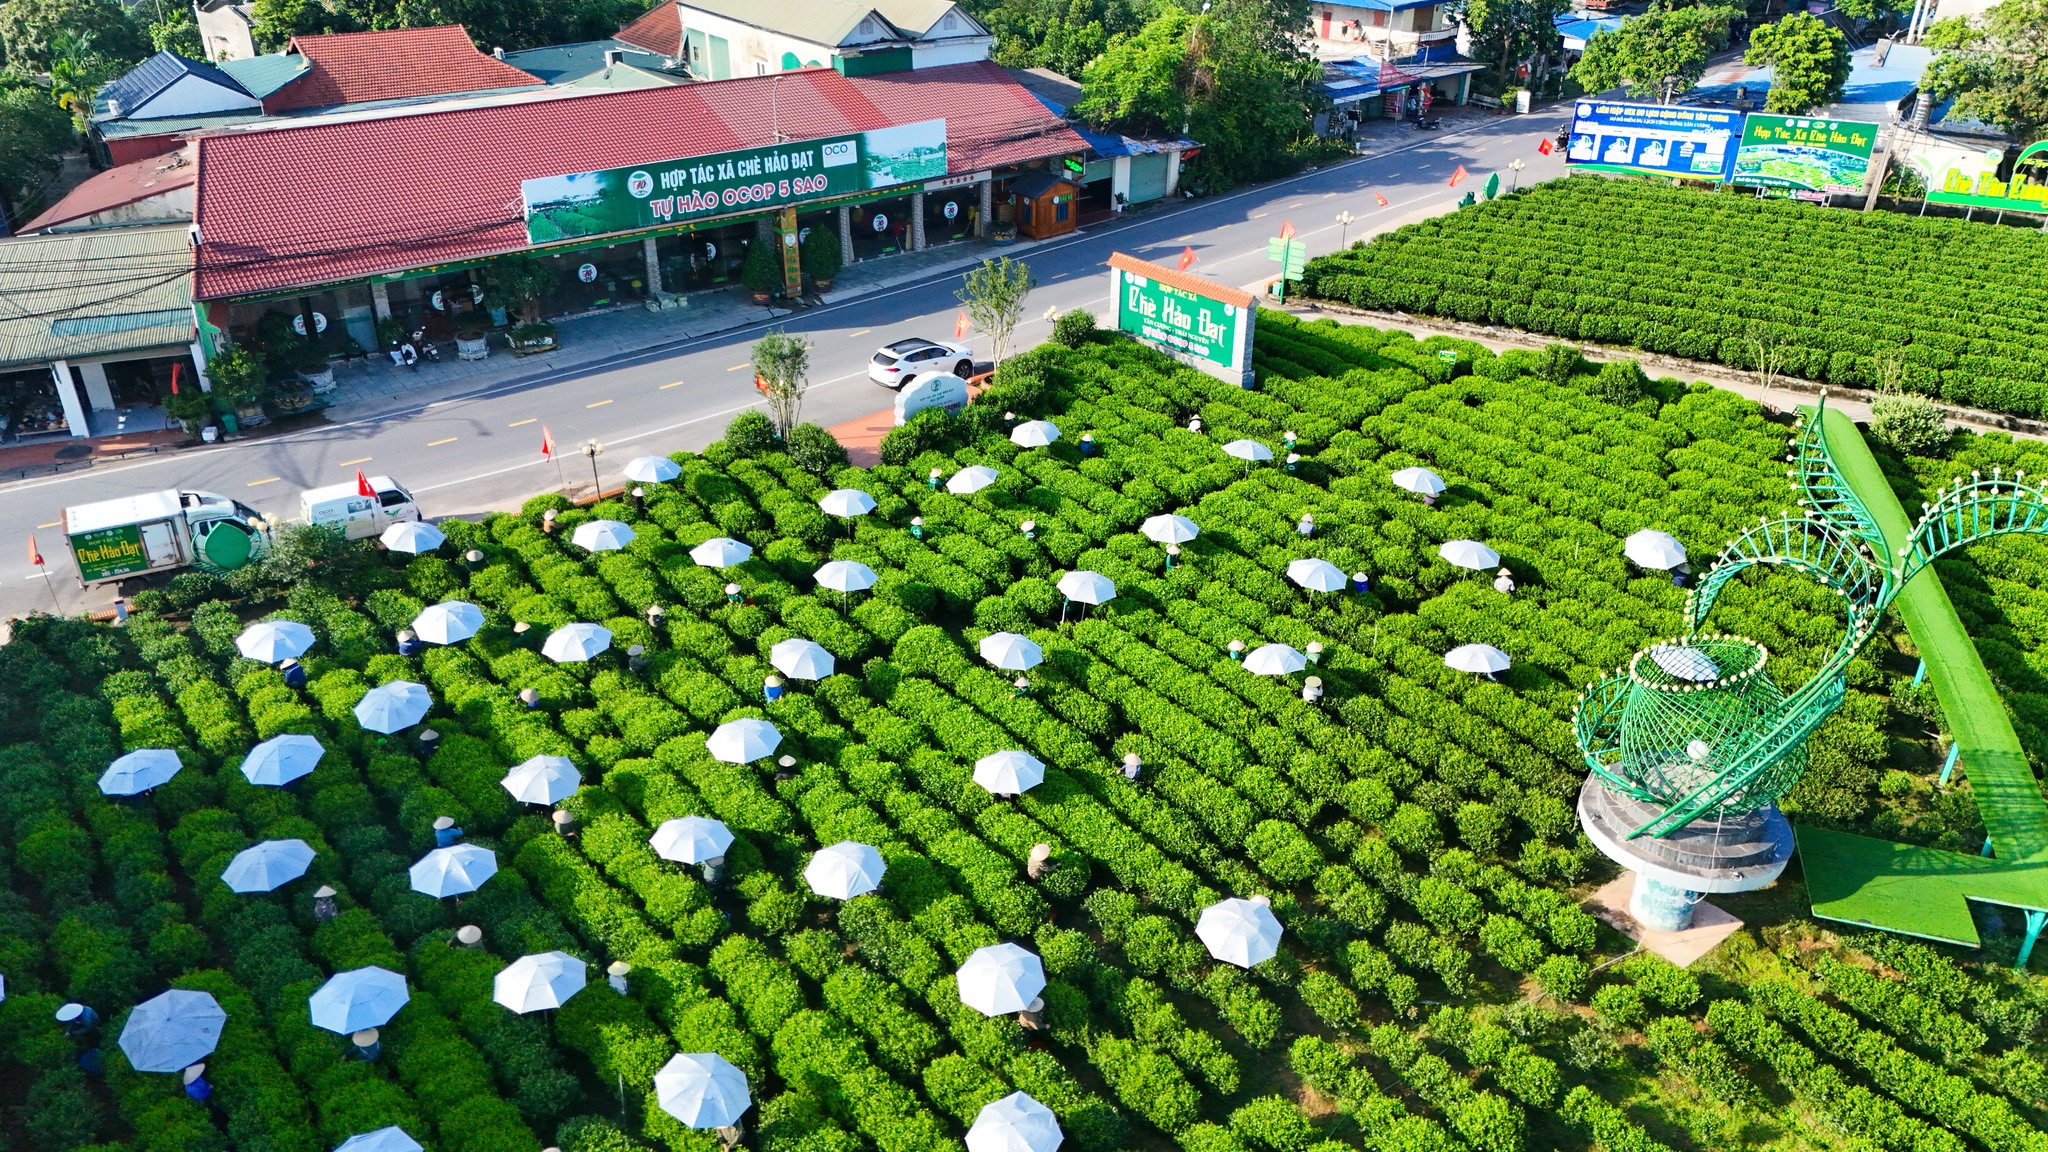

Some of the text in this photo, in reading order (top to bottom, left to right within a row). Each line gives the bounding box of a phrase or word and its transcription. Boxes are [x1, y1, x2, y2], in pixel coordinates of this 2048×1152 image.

[660, 150, 813, 191] HỢP TÁC XÃ CHÈ HẢO ĐẠT
[650, 174, 828, 220] TỰ HÀO OCOP 5 SAO
[1128, 285, 1227, 347] Chè Hảo Đạt
[77, 548, 100, 564] Chè
[99, 544, 121, 560] Hảo
[120, 540, 141, 557] Đạt
